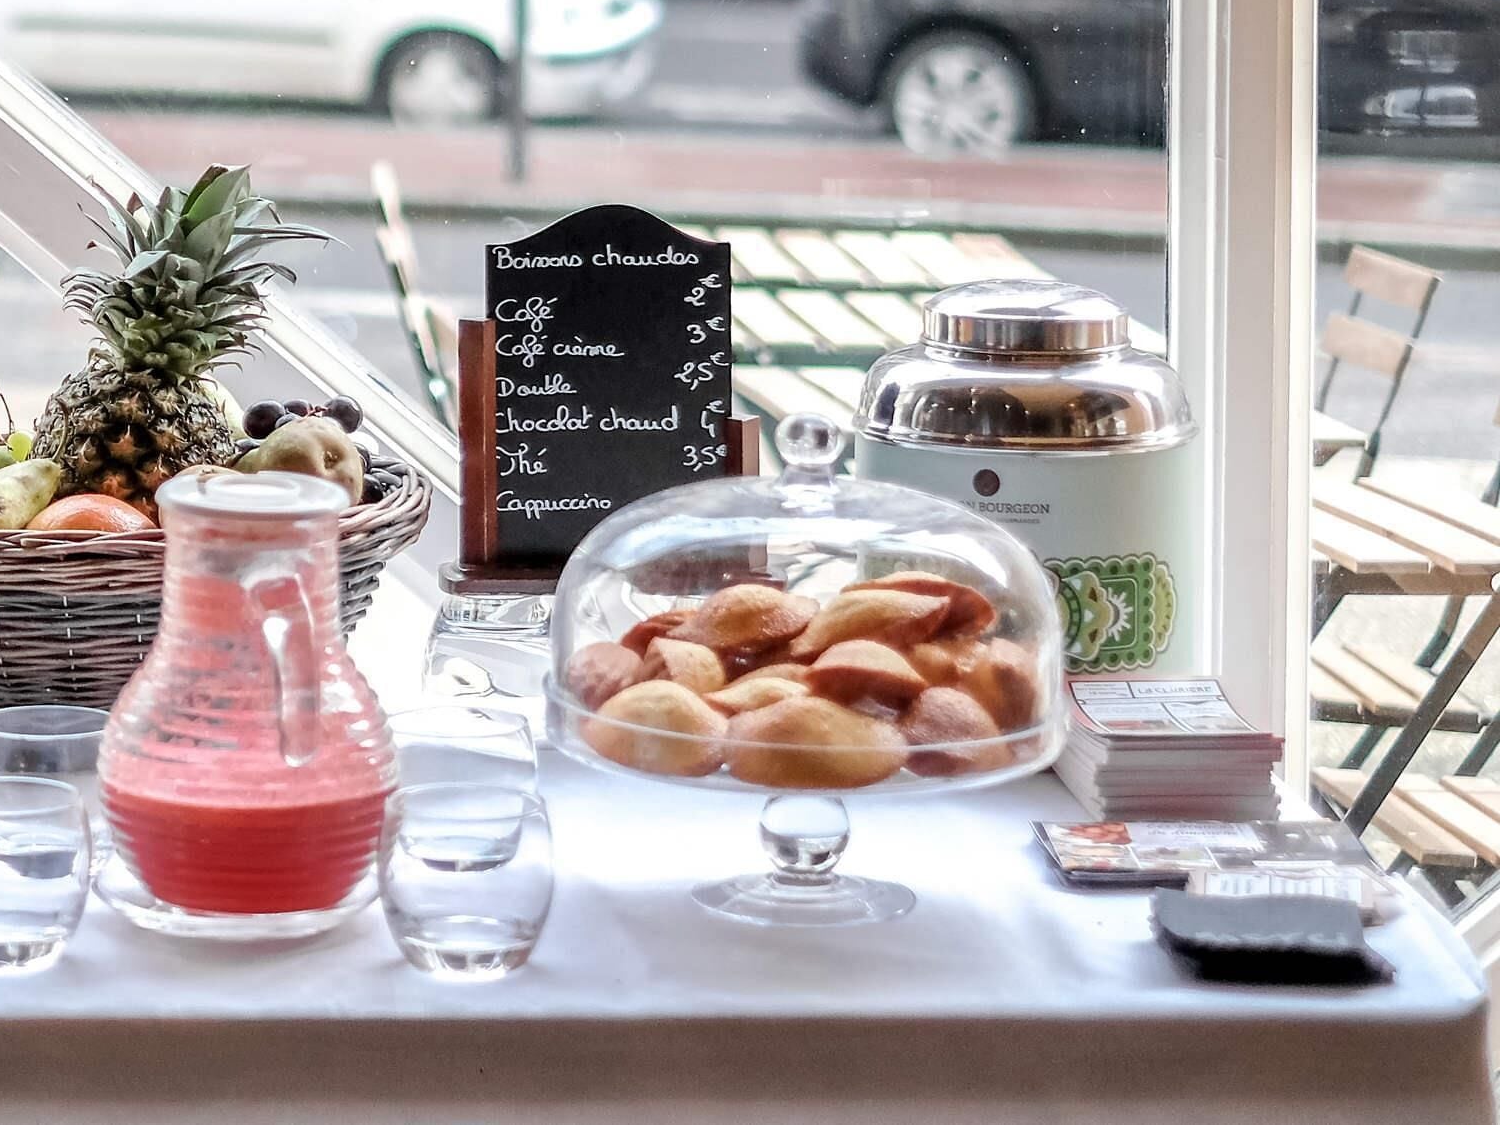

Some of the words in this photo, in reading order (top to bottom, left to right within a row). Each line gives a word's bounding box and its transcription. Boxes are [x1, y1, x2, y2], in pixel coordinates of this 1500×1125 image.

[592, 243, 700, 267] chaudes
[495, 296, 559, 333] Café
[495, 334, 548, 368] Café
[553, 335, 626, 357] crème
[495, 373, 577, 397] Double
[599, 405, 680, 432] chaud
[495, 442, 548, 476] Thé
[495, 490, 612, 520] Cappuccino
[979, 501, 1051, 515] BOURGEON
